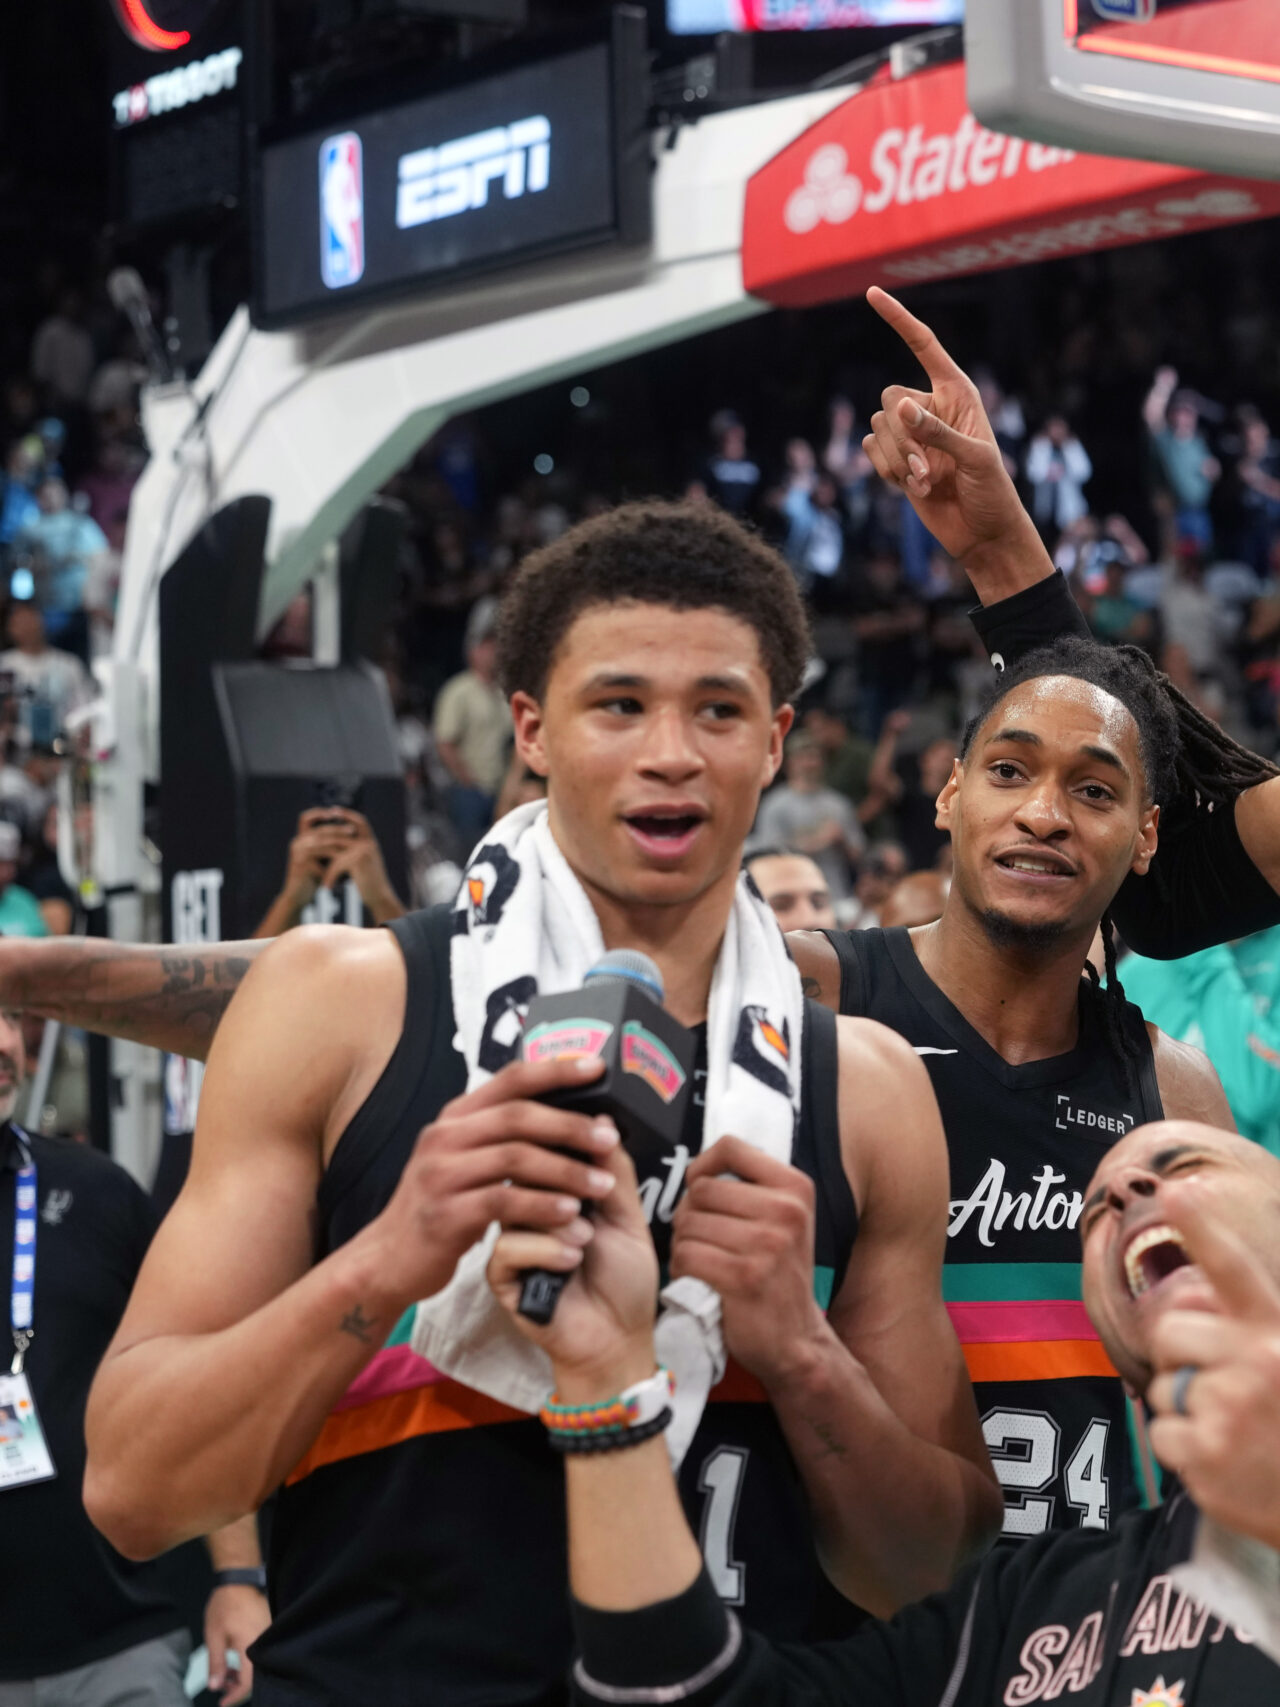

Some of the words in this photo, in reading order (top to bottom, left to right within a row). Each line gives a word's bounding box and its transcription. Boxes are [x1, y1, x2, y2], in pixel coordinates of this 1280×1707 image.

[397, 113, 551, 229] ESPN
[1066, 1106, 1126, 1135] LEDGER
[980, 1405, 1112, 1540] 24
[1003, 1610, 1104, 1706] SA
